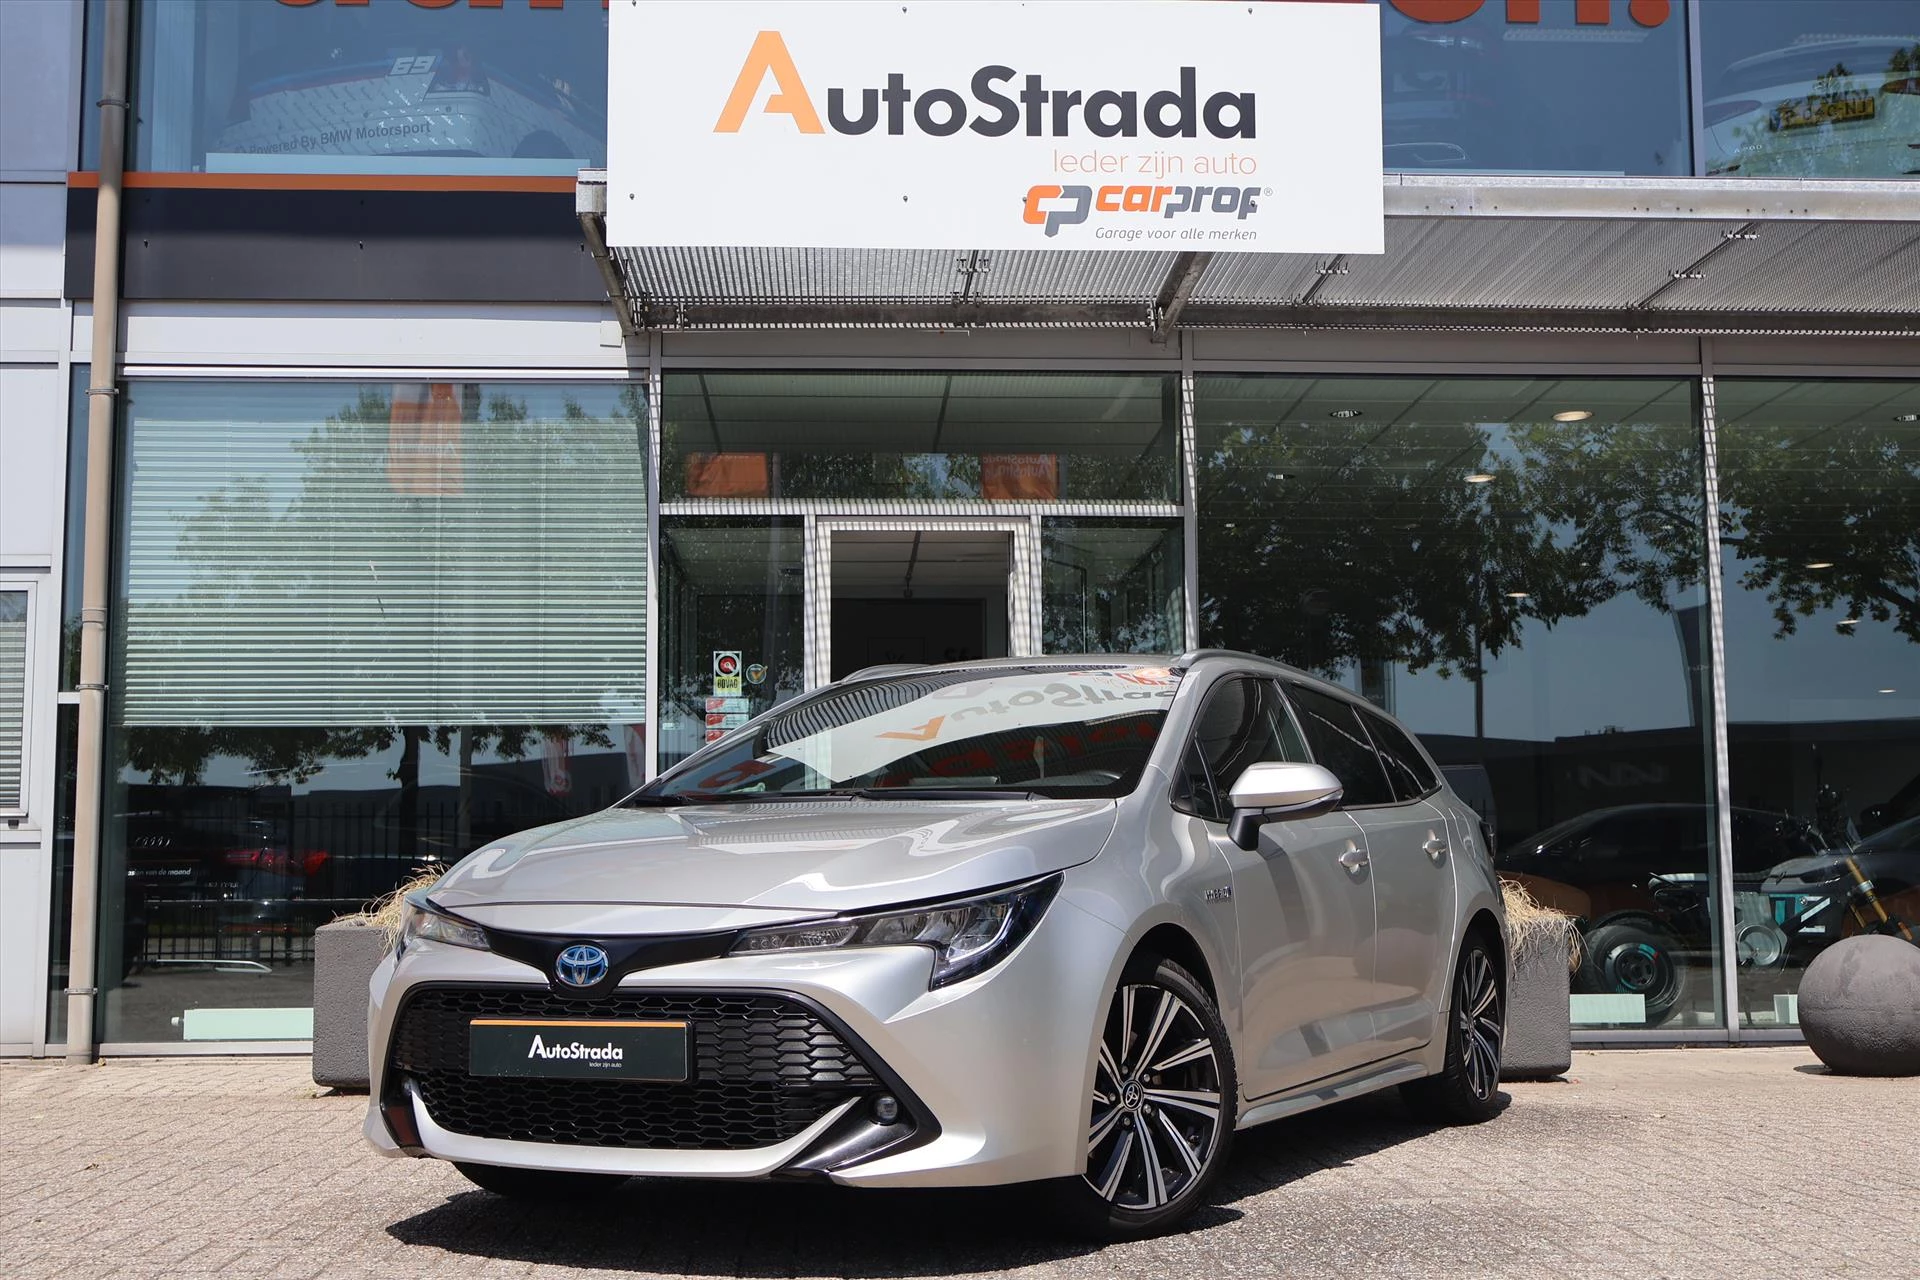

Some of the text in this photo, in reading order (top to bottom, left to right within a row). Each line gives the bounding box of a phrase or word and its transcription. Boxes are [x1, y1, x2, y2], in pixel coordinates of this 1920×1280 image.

[390, 56, 437, 75] 69
[712, 30, 1257, 139] AutoStrada
[249, 121, 432, 154] Powered By BMW Motorsport
[1053, 149, 1257, 179] Ieder zijn auto
[1095, 185, 1262, 220] carprof
[1095, 227, 1257, 242] Garage voor alle merken
[717, 679, 738, 689] BOVAG
[168, 867, 192, 876] maand
[527, 1034, 623, 1060] AutoStrada
[602, 1061, 611, 1069] zijn
